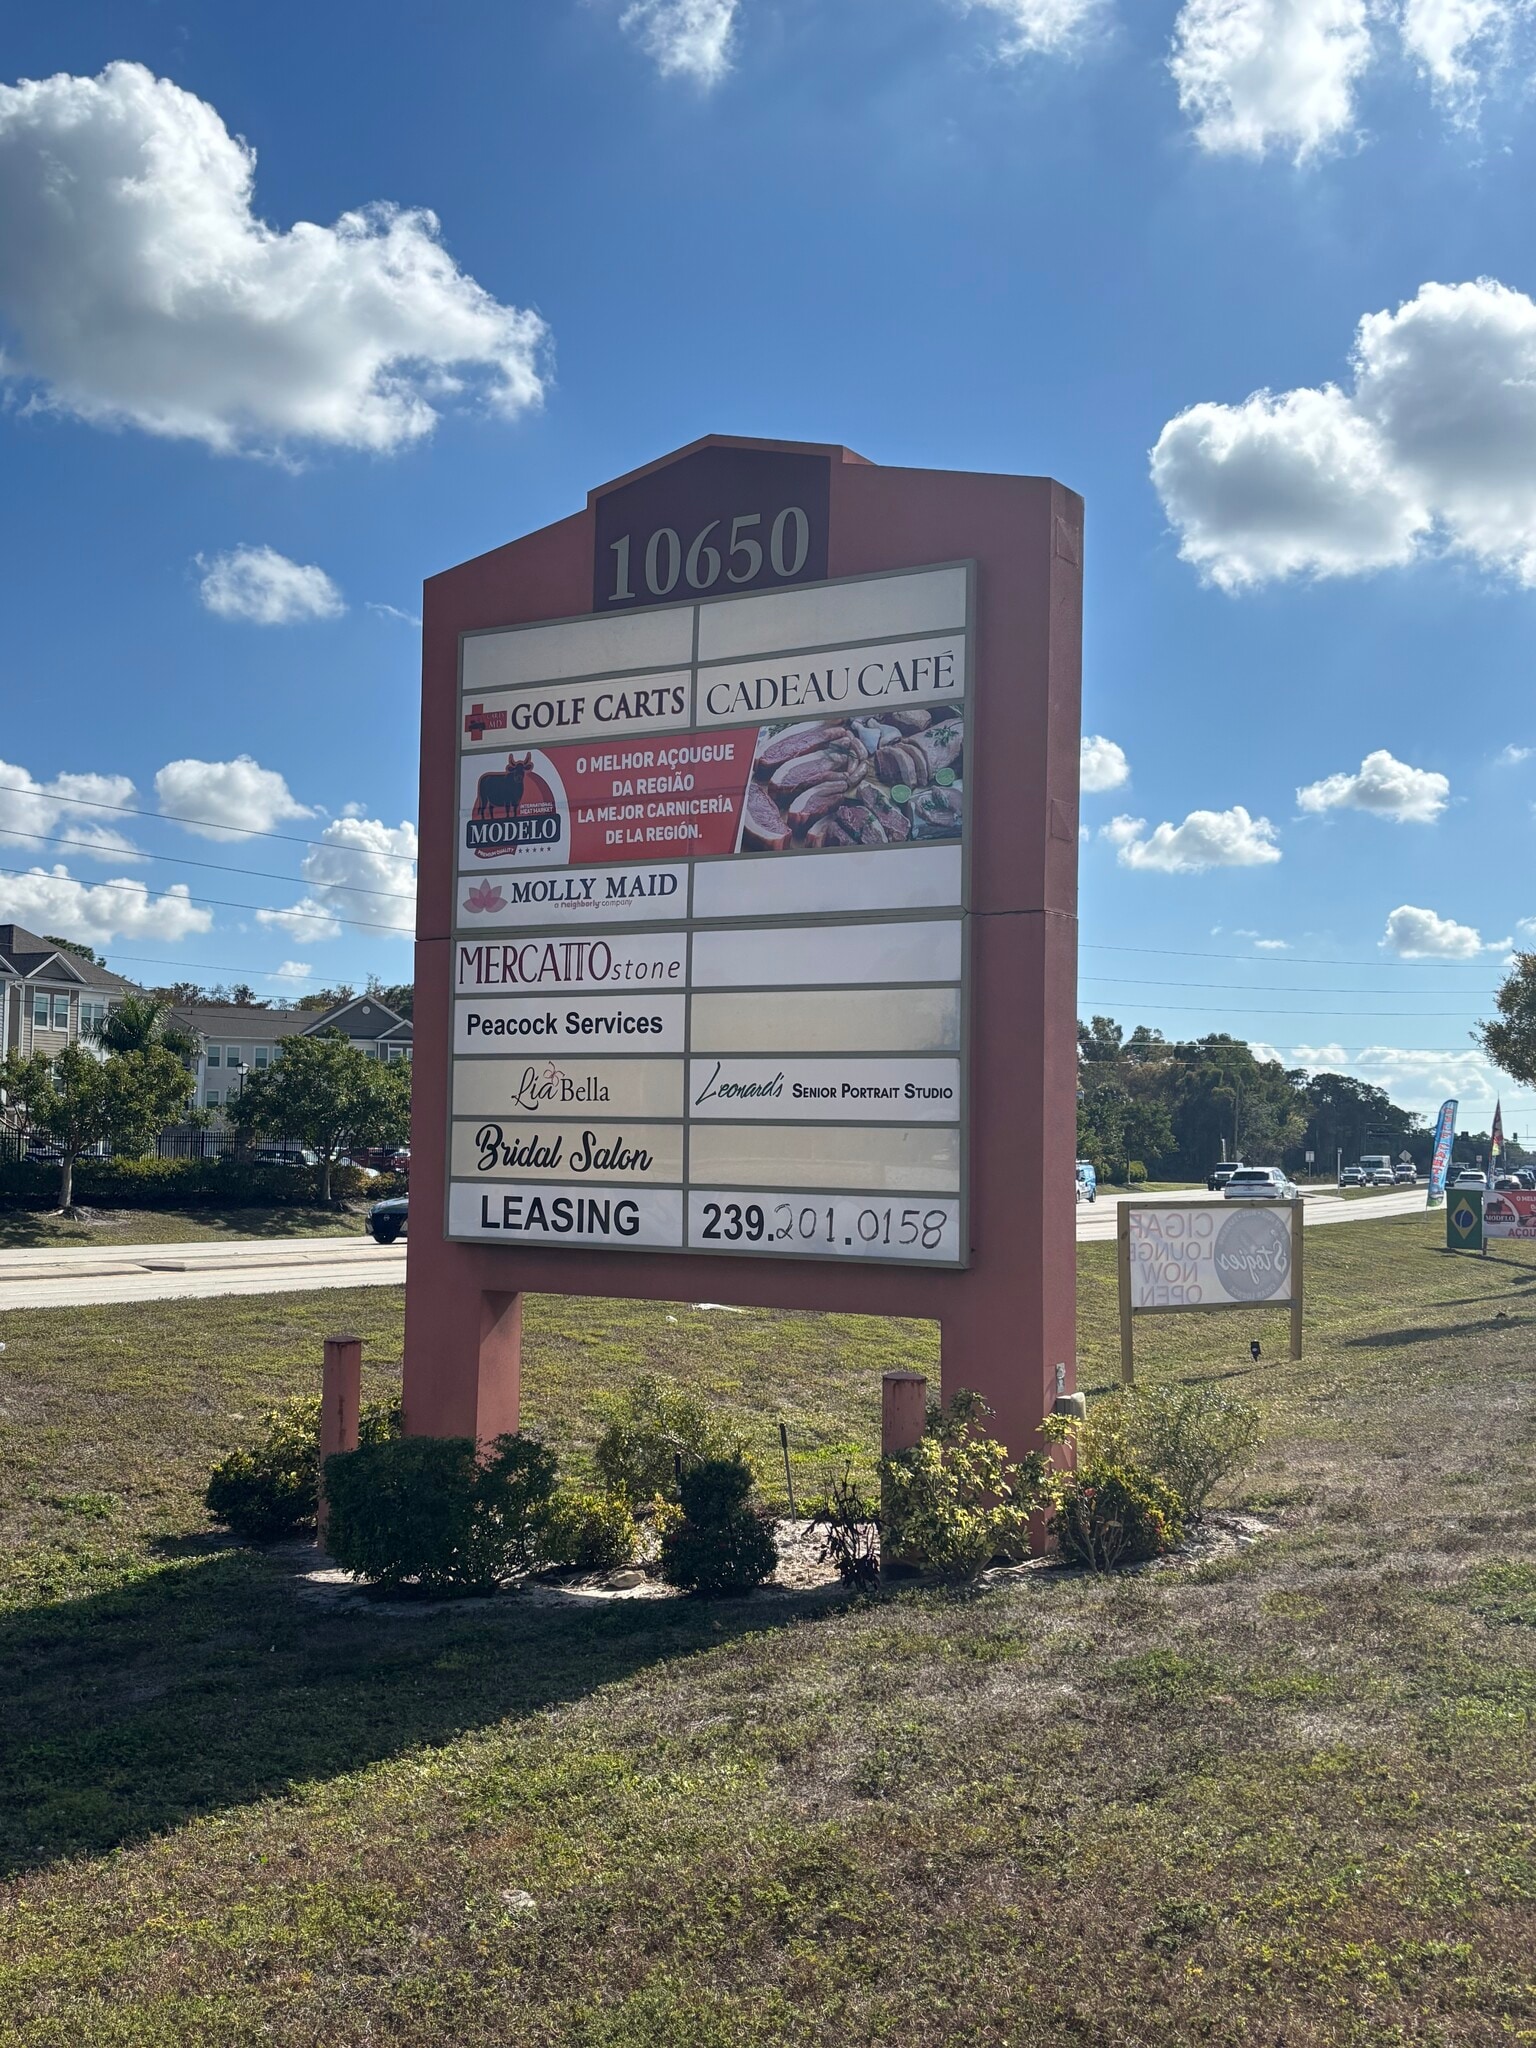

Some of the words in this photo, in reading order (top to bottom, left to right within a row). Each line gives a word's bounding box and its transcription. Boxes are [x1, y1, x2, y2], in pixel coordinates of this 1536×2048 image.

[608, 507, 810, 601] 10650
[706, 667, 850, 715] CADEAU
[857, 649, 955, 697] CAFÉ
[511, 698, 585, 730] GOLF
[593, 686, 685, 722] CARTS
[489, 719, 502, 728] MD
[576, 757, 587, 773] O
[590, 751, 654, 772] MELHOR
[657, 744, 734, 771] AÇOUGUE
[612, 779, 634, 796] DA
[637, 772, 694, 793] REGIÃO
[577, 809, 594, 823] LA
[597, 803, 644, 821] MEJOR
[647, 795, 733, 818] CARNICERÍA
[470, 818, 557, 844] MODELO
[605, 829, 623, 844] DE
[626, 828, 643, 843] LA
[646, 823, 702, 841] REGIÓN.
[511, 878, 597, 903] MOLLY
[606, 873, 678, 898] MAID
[561, 900, 600, 909] neighborly
[601, 899, 632, 907] company
[459, 941, 612, 984] MERCATTO
[611, 960, 681, 980] stone
[467, 1012, 558, 1036] Peacock
[565, 1011, 663, 1034] Services
[560, 1077, 611, 1102] Bella
[695, 1061, 785, 1105] Leonard's
[792, 1083, 837, 1098] SENIOR
[841, 1083, 900, 1099] PORTRAIT
[904, 1083, 953, 1099] STUDIO
[475, 1123, 563, 1171] Bridal
[569, 1131, 654, 1172] Salon
[481, 1195, 640, 1236] LEASING
